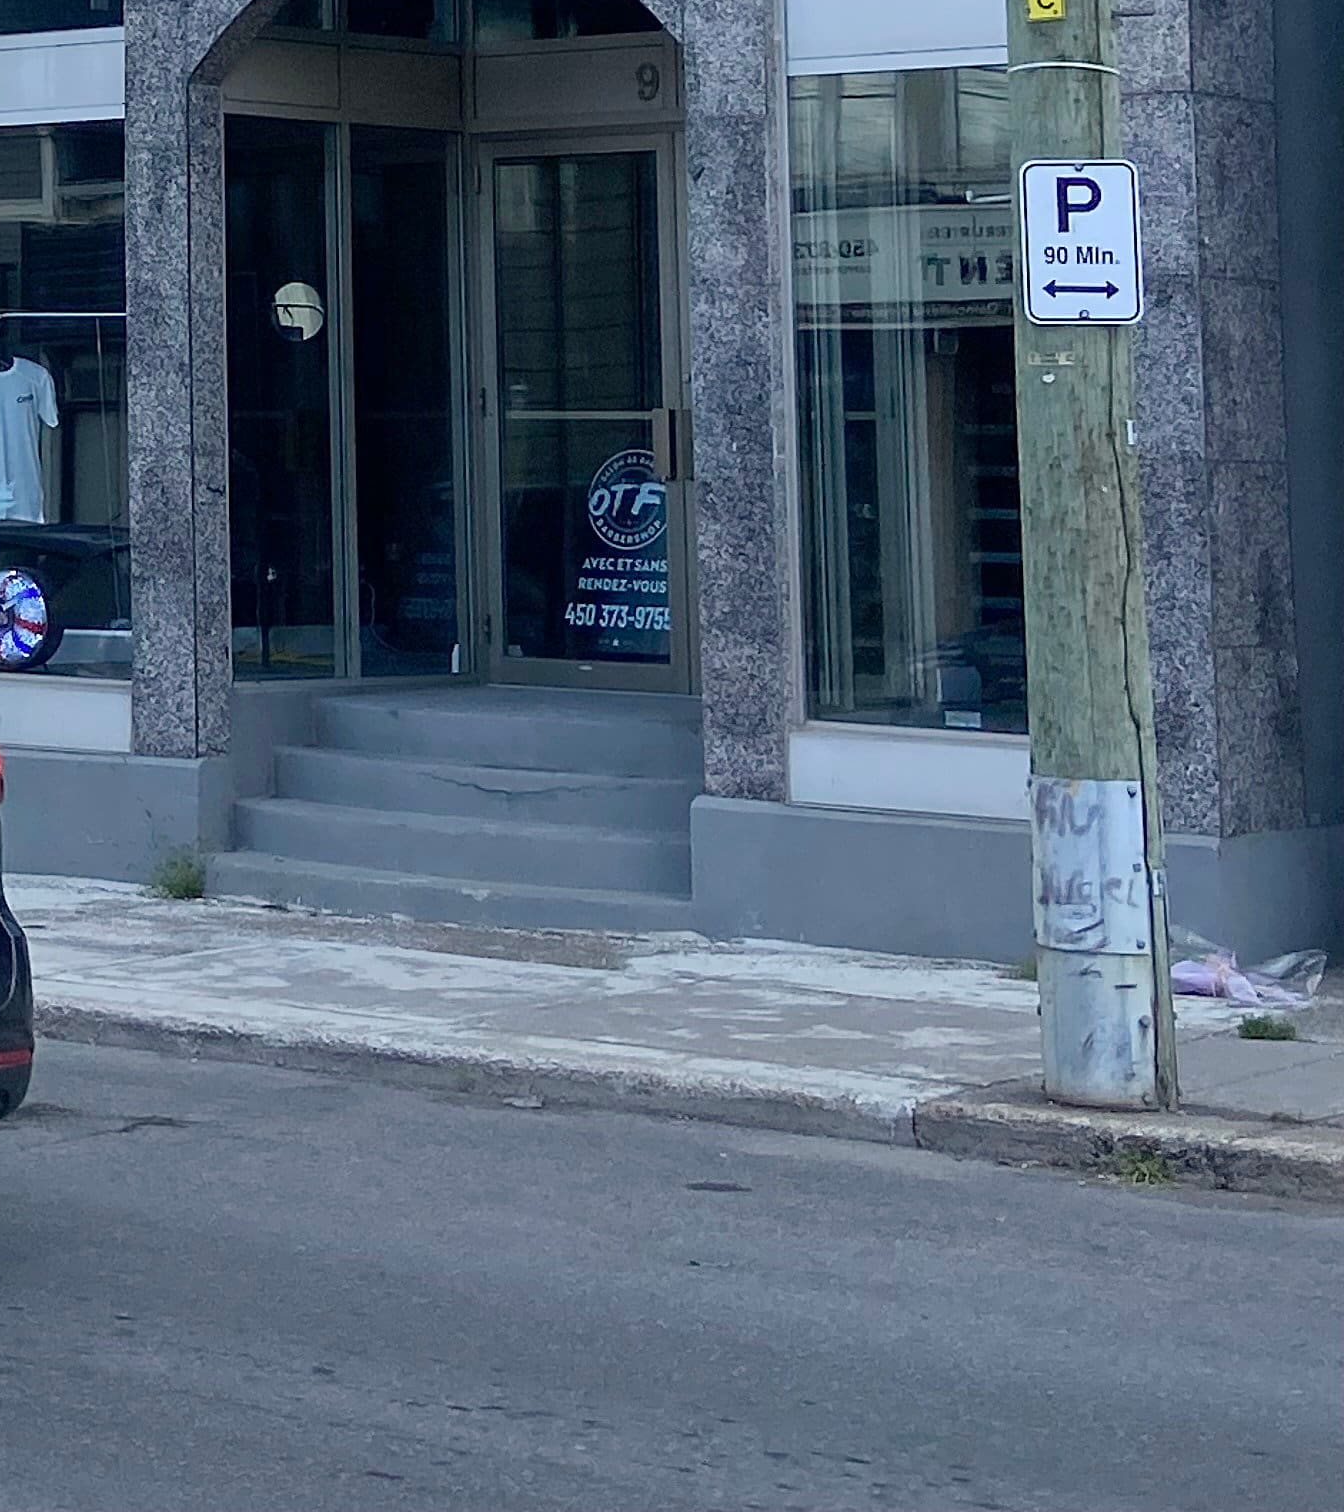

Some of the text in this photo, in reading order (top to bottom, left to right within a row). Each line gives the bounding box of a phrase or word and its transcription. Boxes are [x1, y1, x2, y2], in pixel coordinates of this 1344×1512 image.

[635, 62, 660, 102] 9
[1056, 176, 1102, 233] P
[1044, 246, 1068, 265] 90
[589, 482, 667, 517] OTF
[582, 557, 668, 572] AVEC ET SANS
[578, 577, 668, 593] RENDEZ-VOUS
[564, 601, 597, 626] 450
